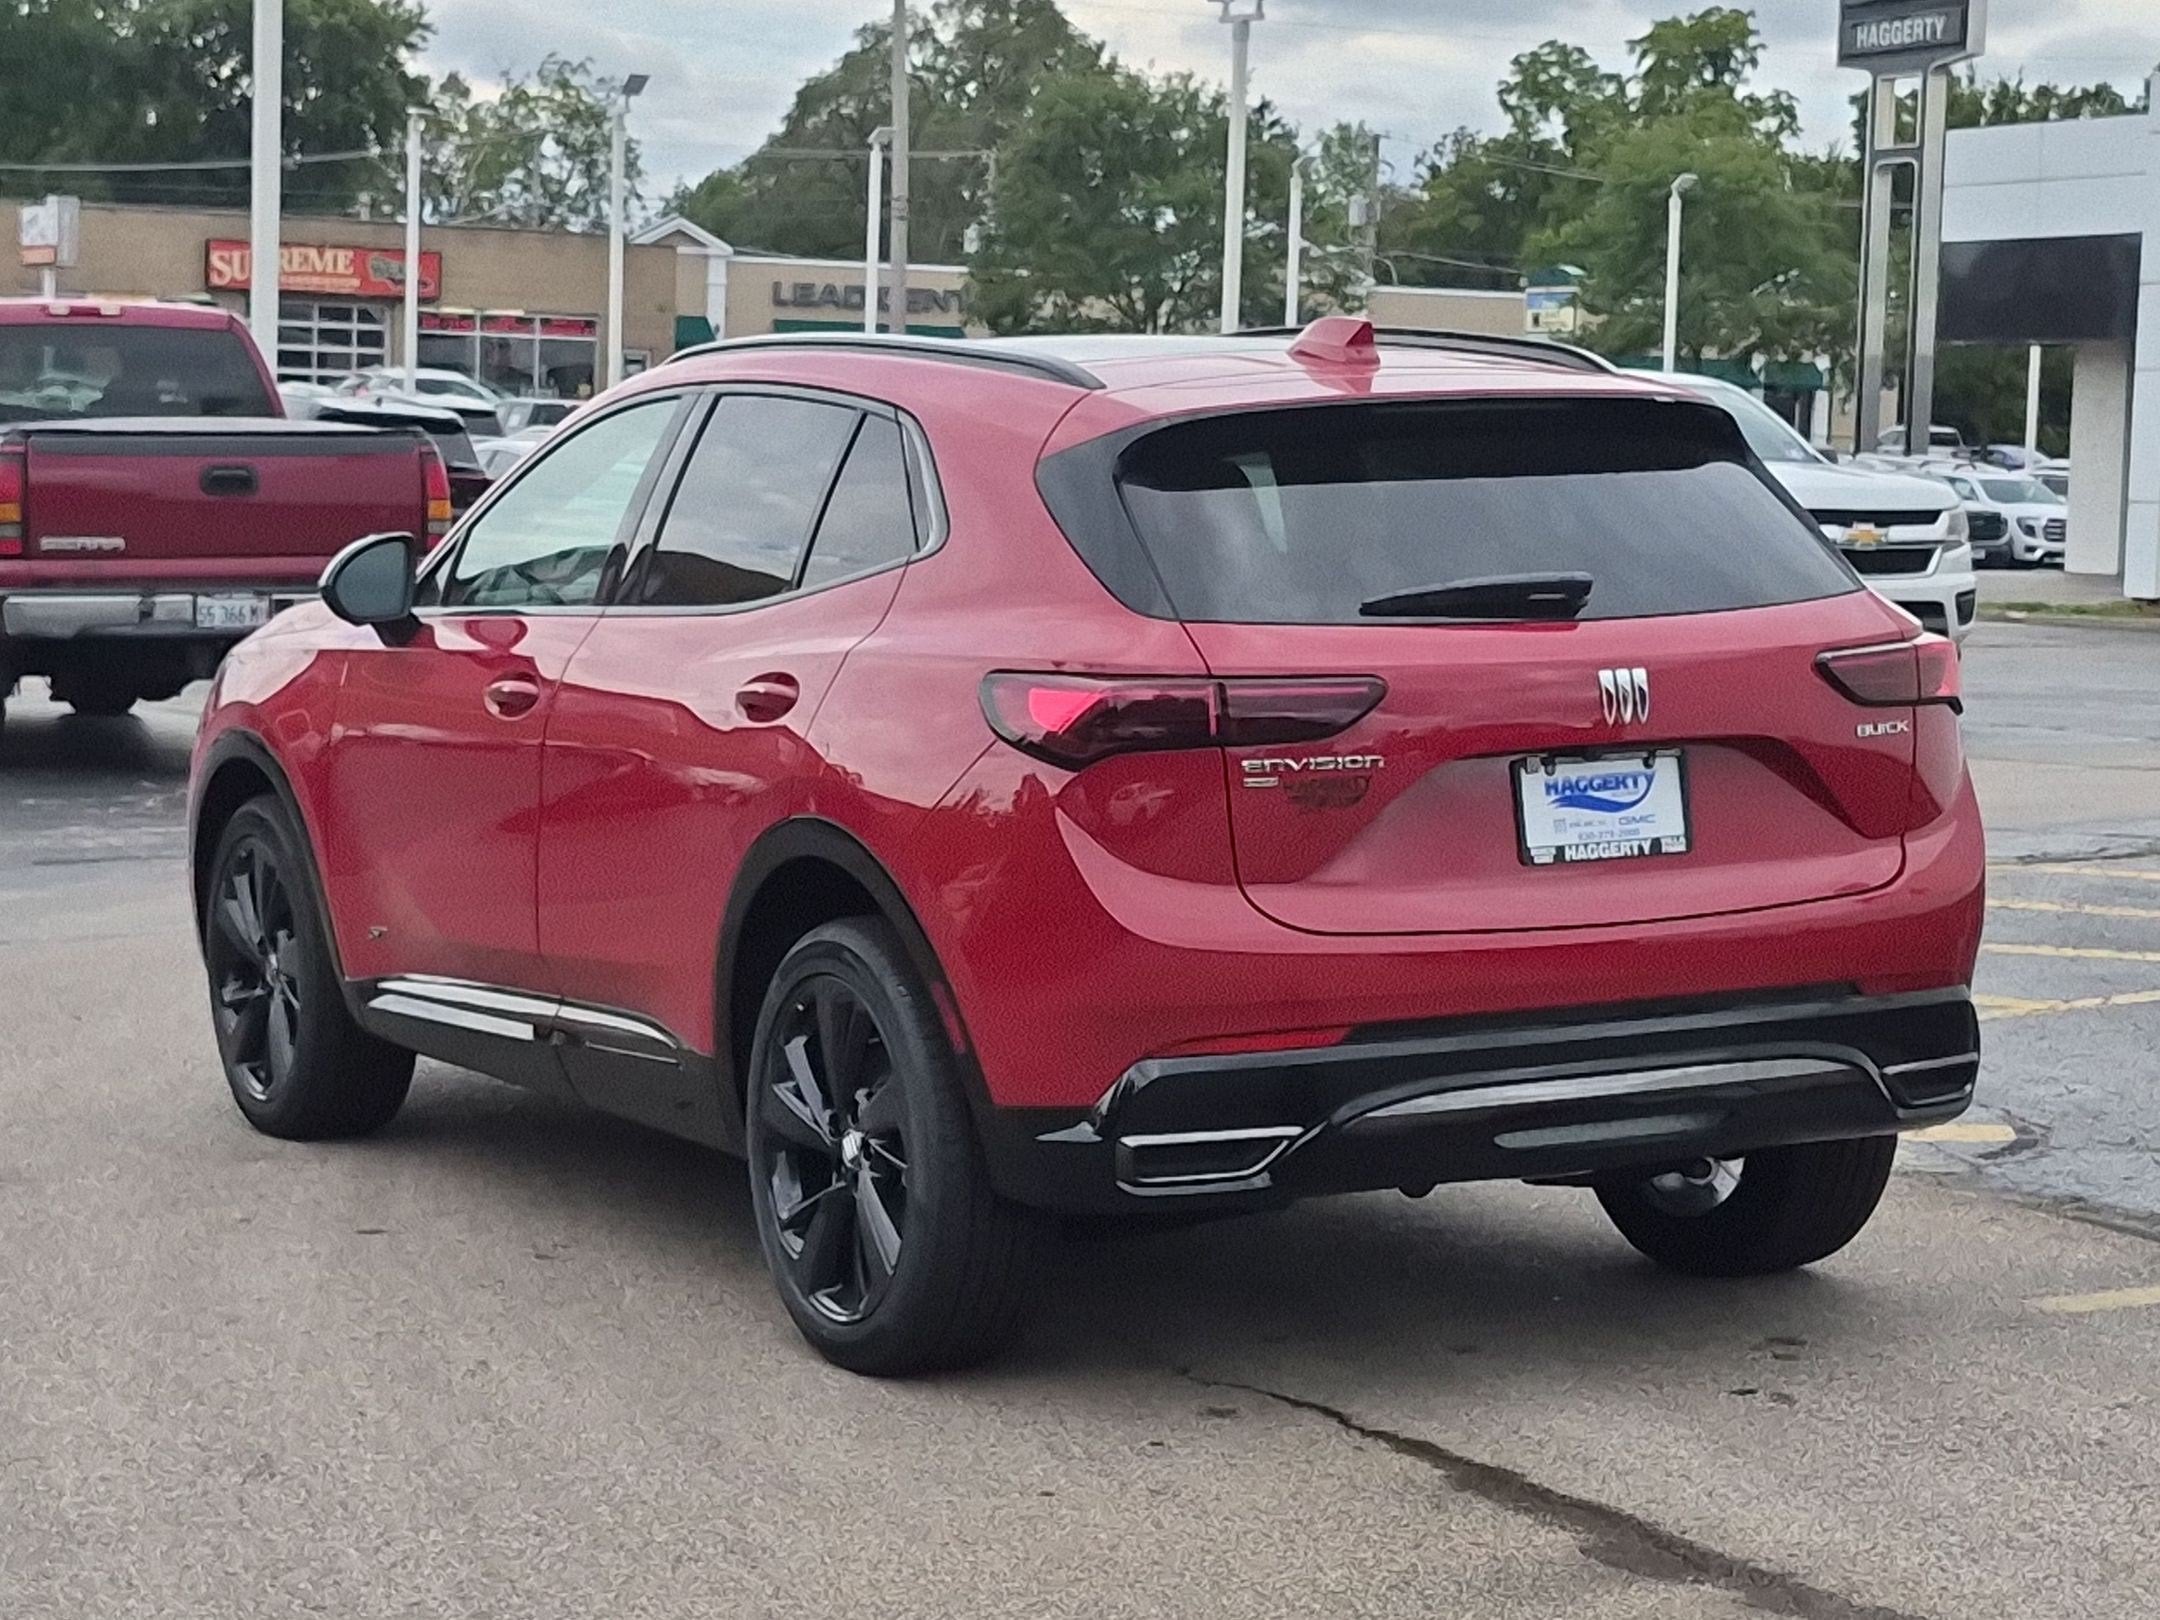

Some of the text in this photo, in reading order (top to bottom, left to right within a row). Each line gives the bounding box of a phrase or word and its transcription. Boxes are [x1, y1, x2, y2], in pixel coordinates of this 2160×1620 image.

[1856, 15, 1947, 49] HAGGERTY
[209, 246, 354, 286] SUREME
[1857, 720, 1909, 737] BUICK
[1241, 755, 1385, 773] ENVISION
[1544, 770, 1656, 797] HAGGERTY
[1618, 814, 1656, 826] GMC
[1565, 839, 1652, 862] HAGGERTY
